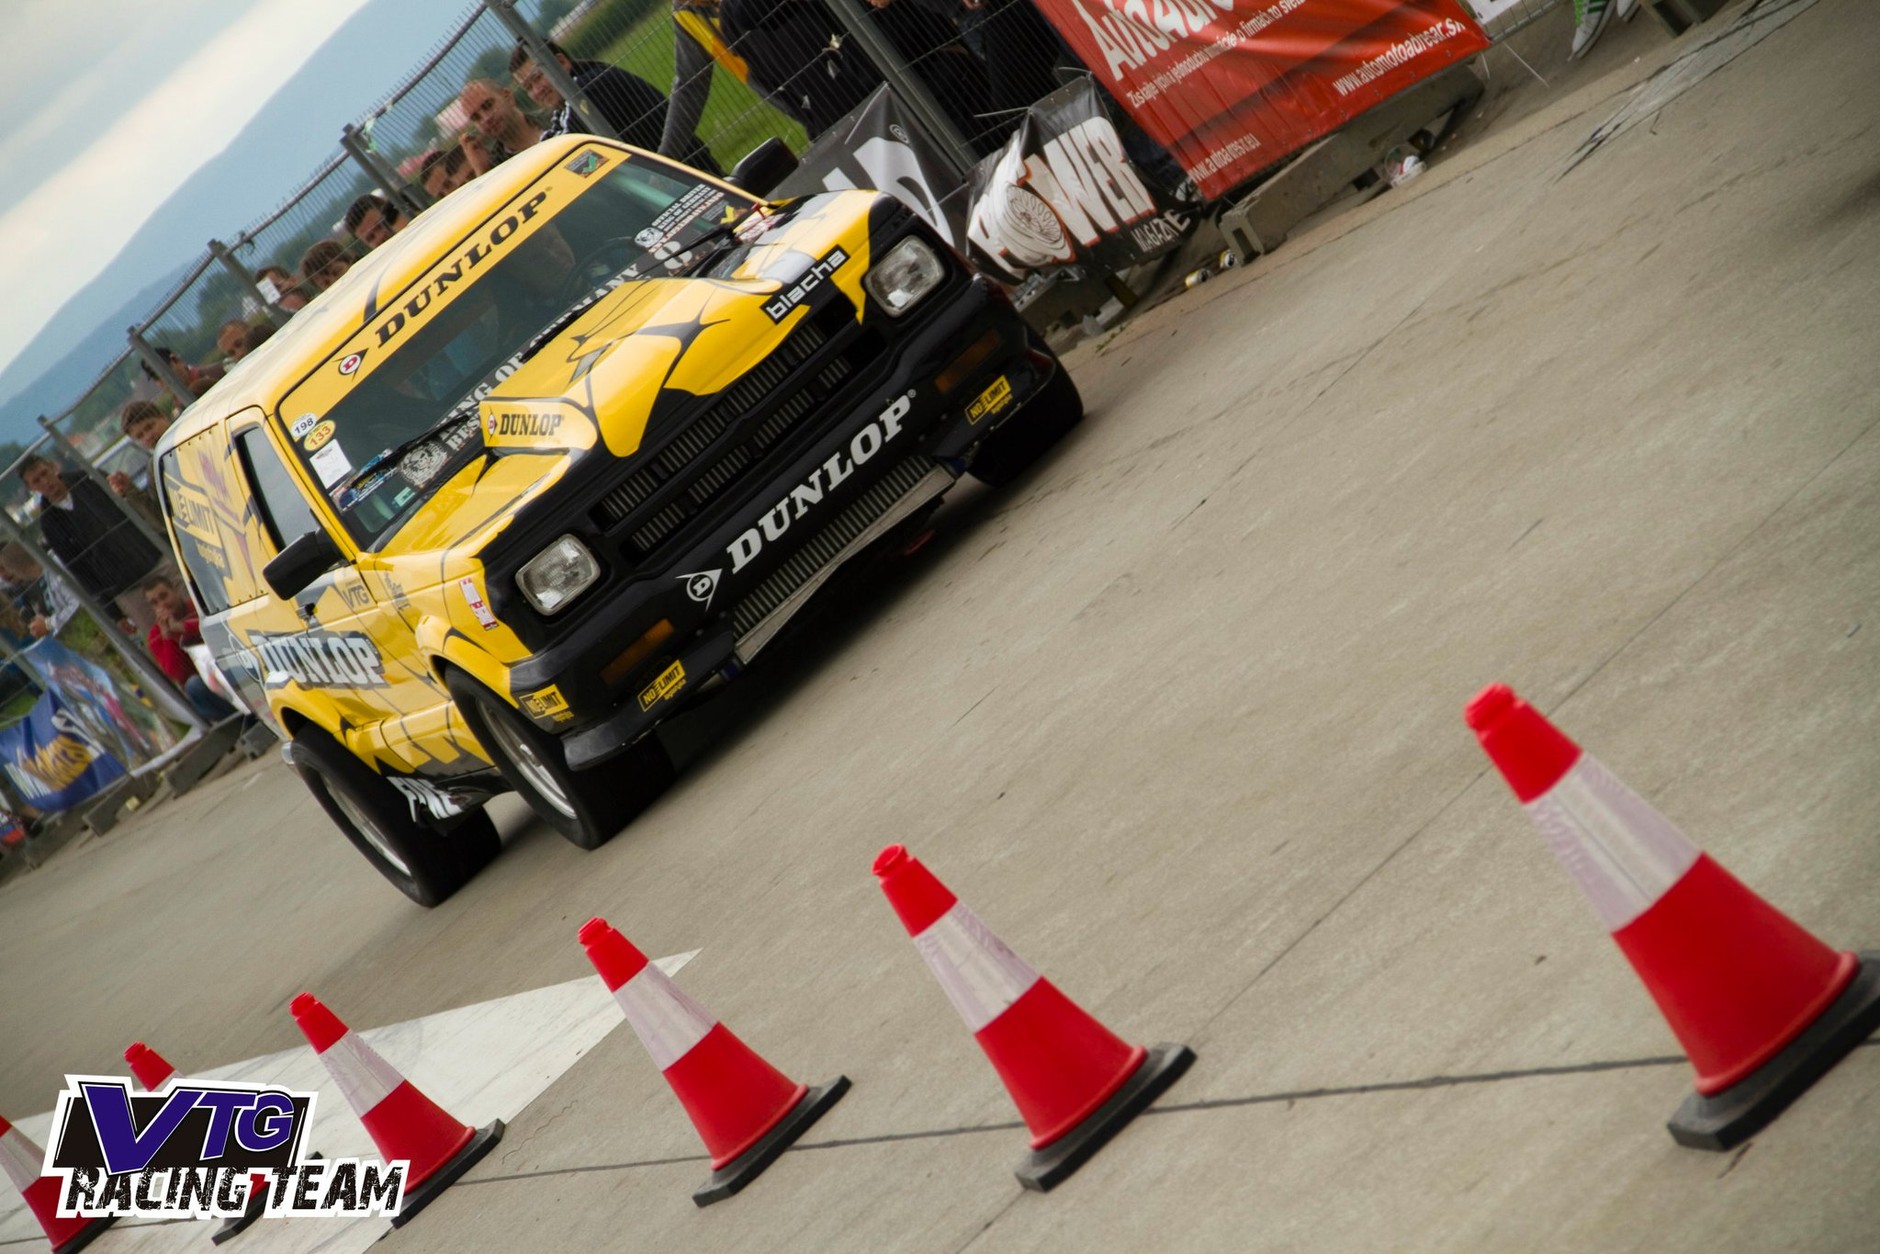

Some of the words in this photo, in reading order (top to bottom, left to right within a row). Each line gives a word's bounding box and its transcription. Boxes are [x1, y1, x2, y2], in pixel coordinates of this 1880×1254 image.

[373, 189, 551, 349] DUNLOP
[765, 250, 847, 320] blacha
[294, 417, 315, 435] 198
[309, 425, 332, 447] 133
[498, 413, 562, 436] DUNLOP
[726, 393, 911, 575] DUNLOP
[249, 634, 386, 684] DUNLOP
